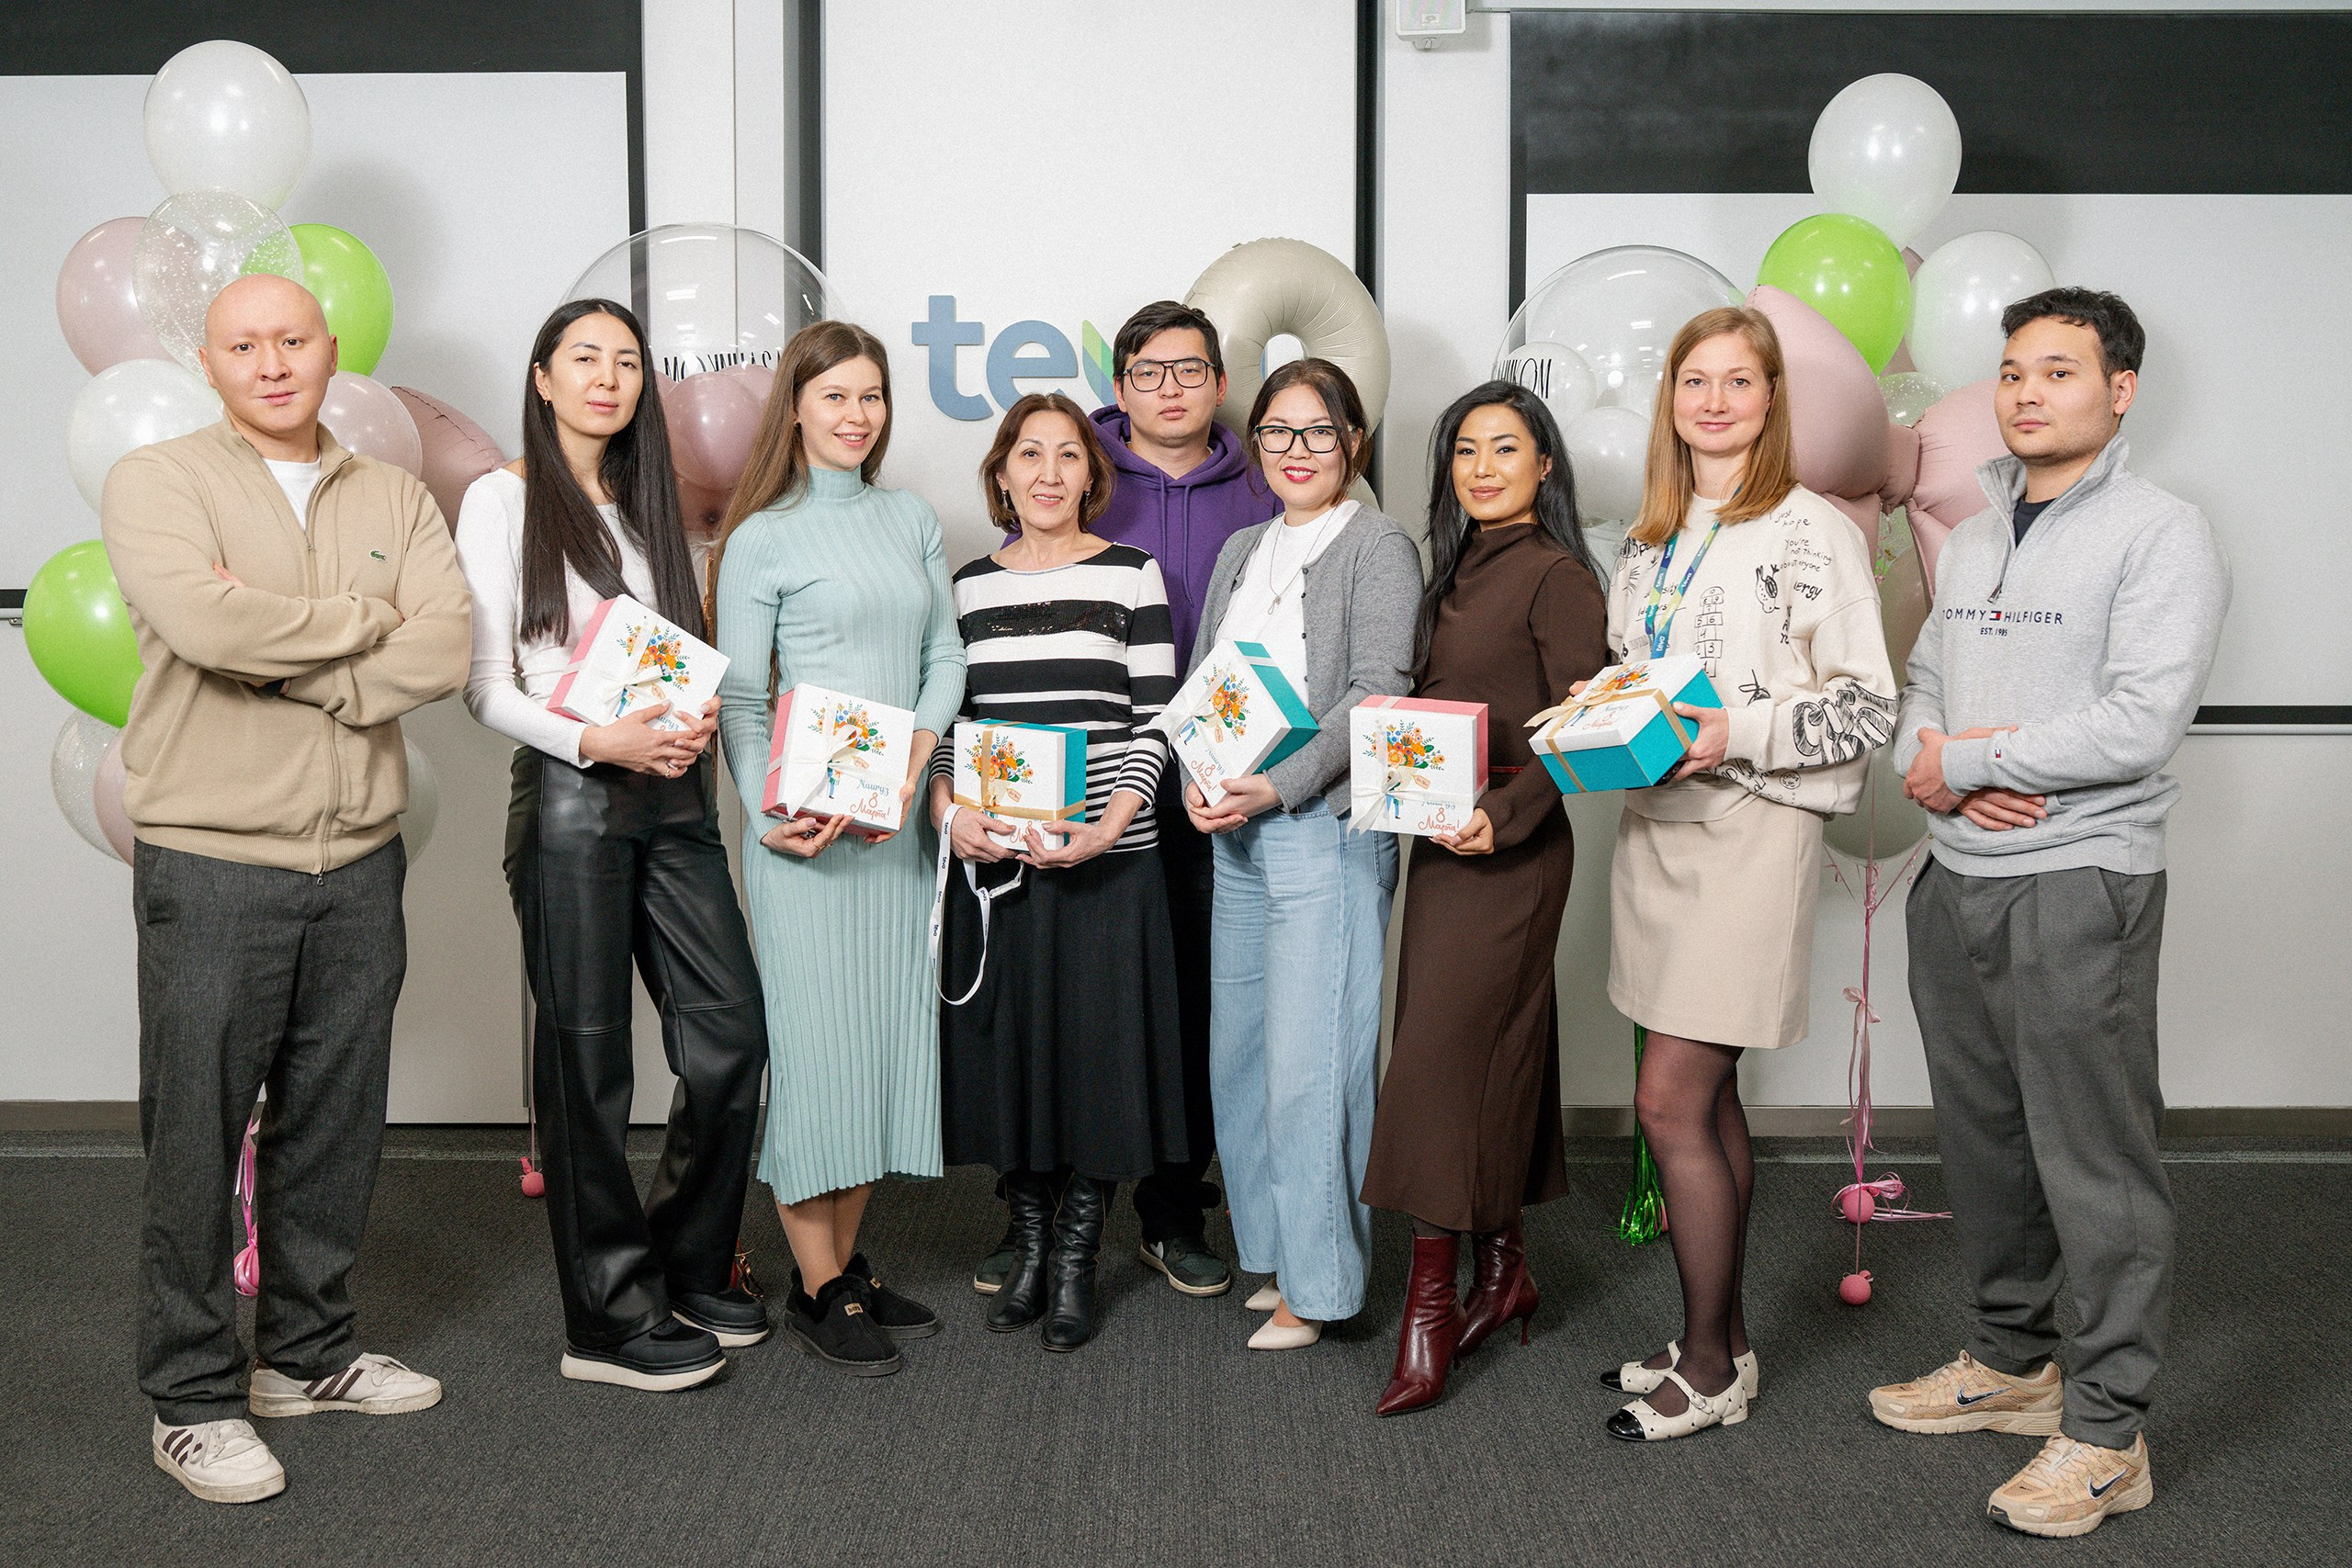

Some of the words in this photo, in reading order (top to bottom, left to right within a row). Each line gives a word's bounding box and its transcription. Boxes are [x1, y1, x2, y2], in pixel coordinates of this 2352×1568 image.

[1656, 572, 1664, 588] teva
[1681, 571, 1693, 589] teva
[1697, 616, 1702, 626] 5
[1942, 608, 1986, 621] OMMY
[2004, 611, 2064, 626] HILFIGER
[1980, 627, 1993, 636] EST.
[1655, 635, 1666, 652] teva
[1707, 643, 1715, 654] 3
[1204, 763, 1216, 777] 8
[868, 792, 878, 808] 8
[850, 797, 891, 820] Марта!
[1436, 807, 1445, 823] 8
